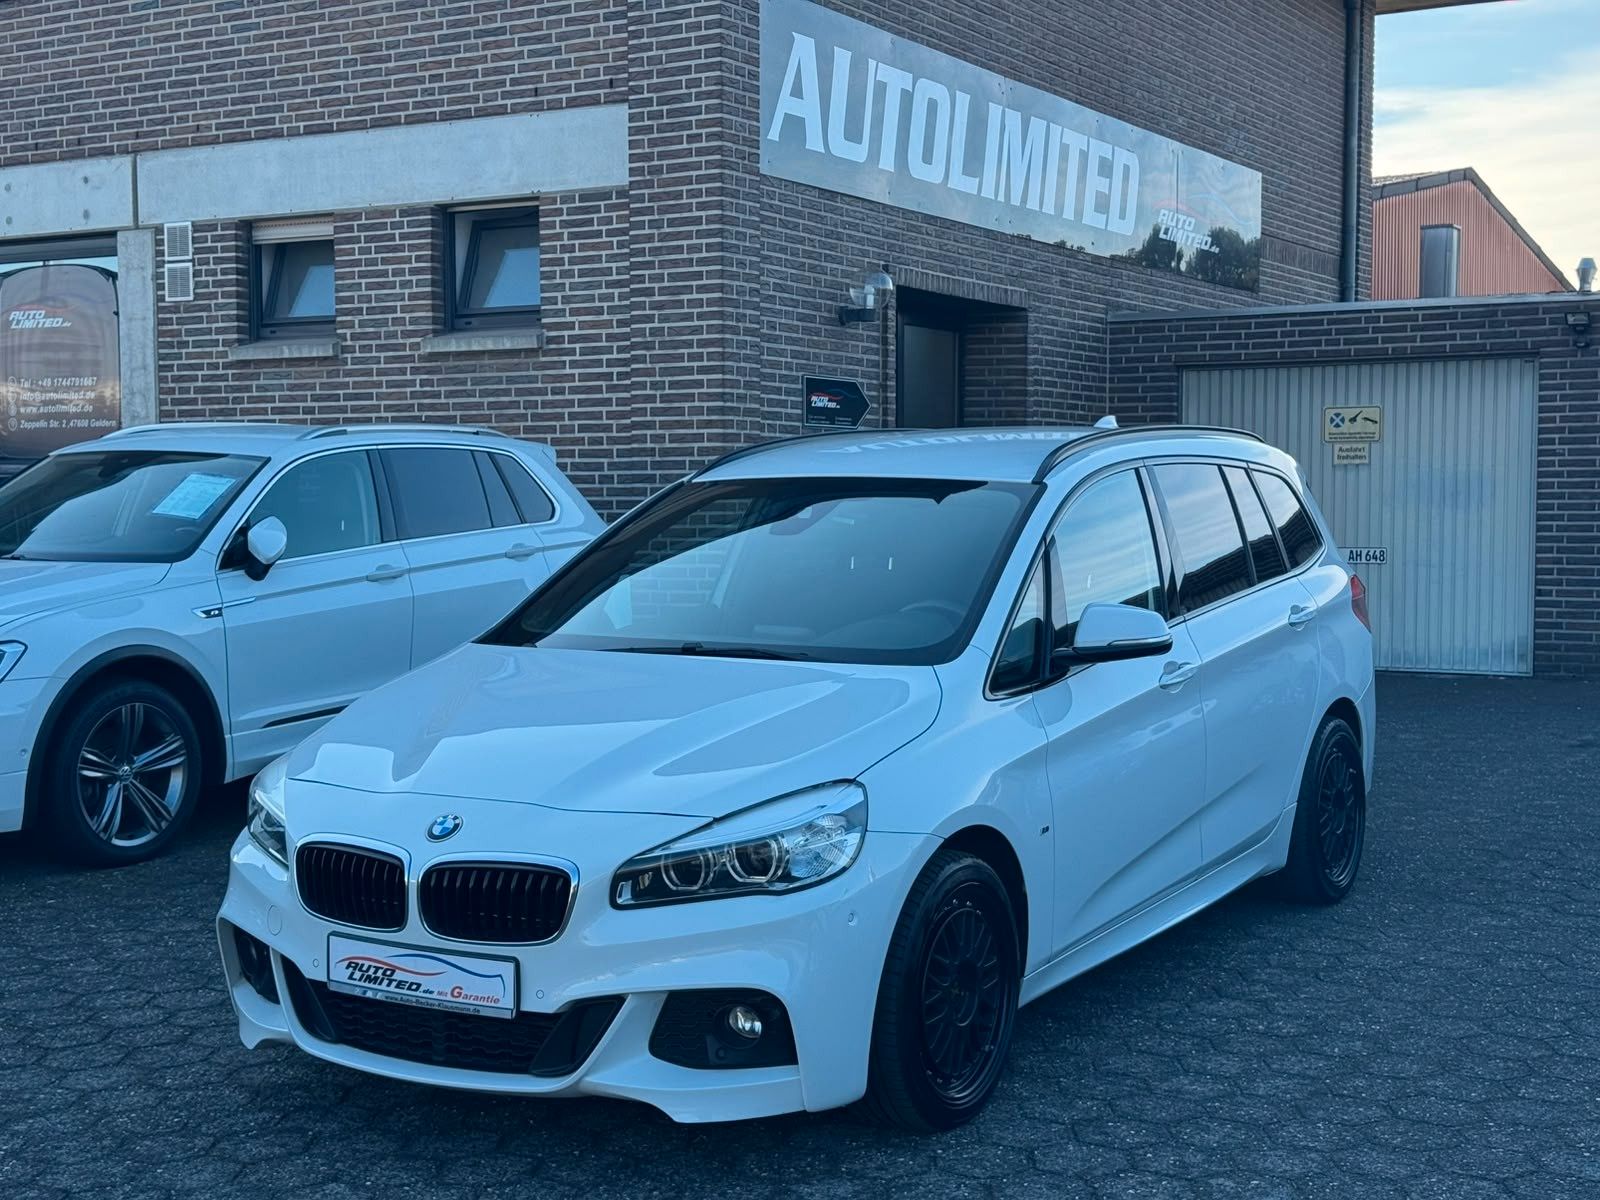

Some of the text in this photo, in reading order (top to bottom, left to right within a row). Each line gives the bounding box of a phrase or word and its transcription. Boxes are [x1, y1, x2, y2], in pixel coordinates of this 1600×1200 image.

[767, 31, 1139, 236] AUTOLIMITED
[1158, 208, 1195, 231] AUTO
[9, 310, 46, 321] AUTO
[38, 378, 52, 387] +49
[20, 404, 93, 414] www.autolimited.de
[1348, 549, 1385, 562] AH 648
[345, 961, 396, 978] AUTO
[450, 985, 501, 1005] Garantie
